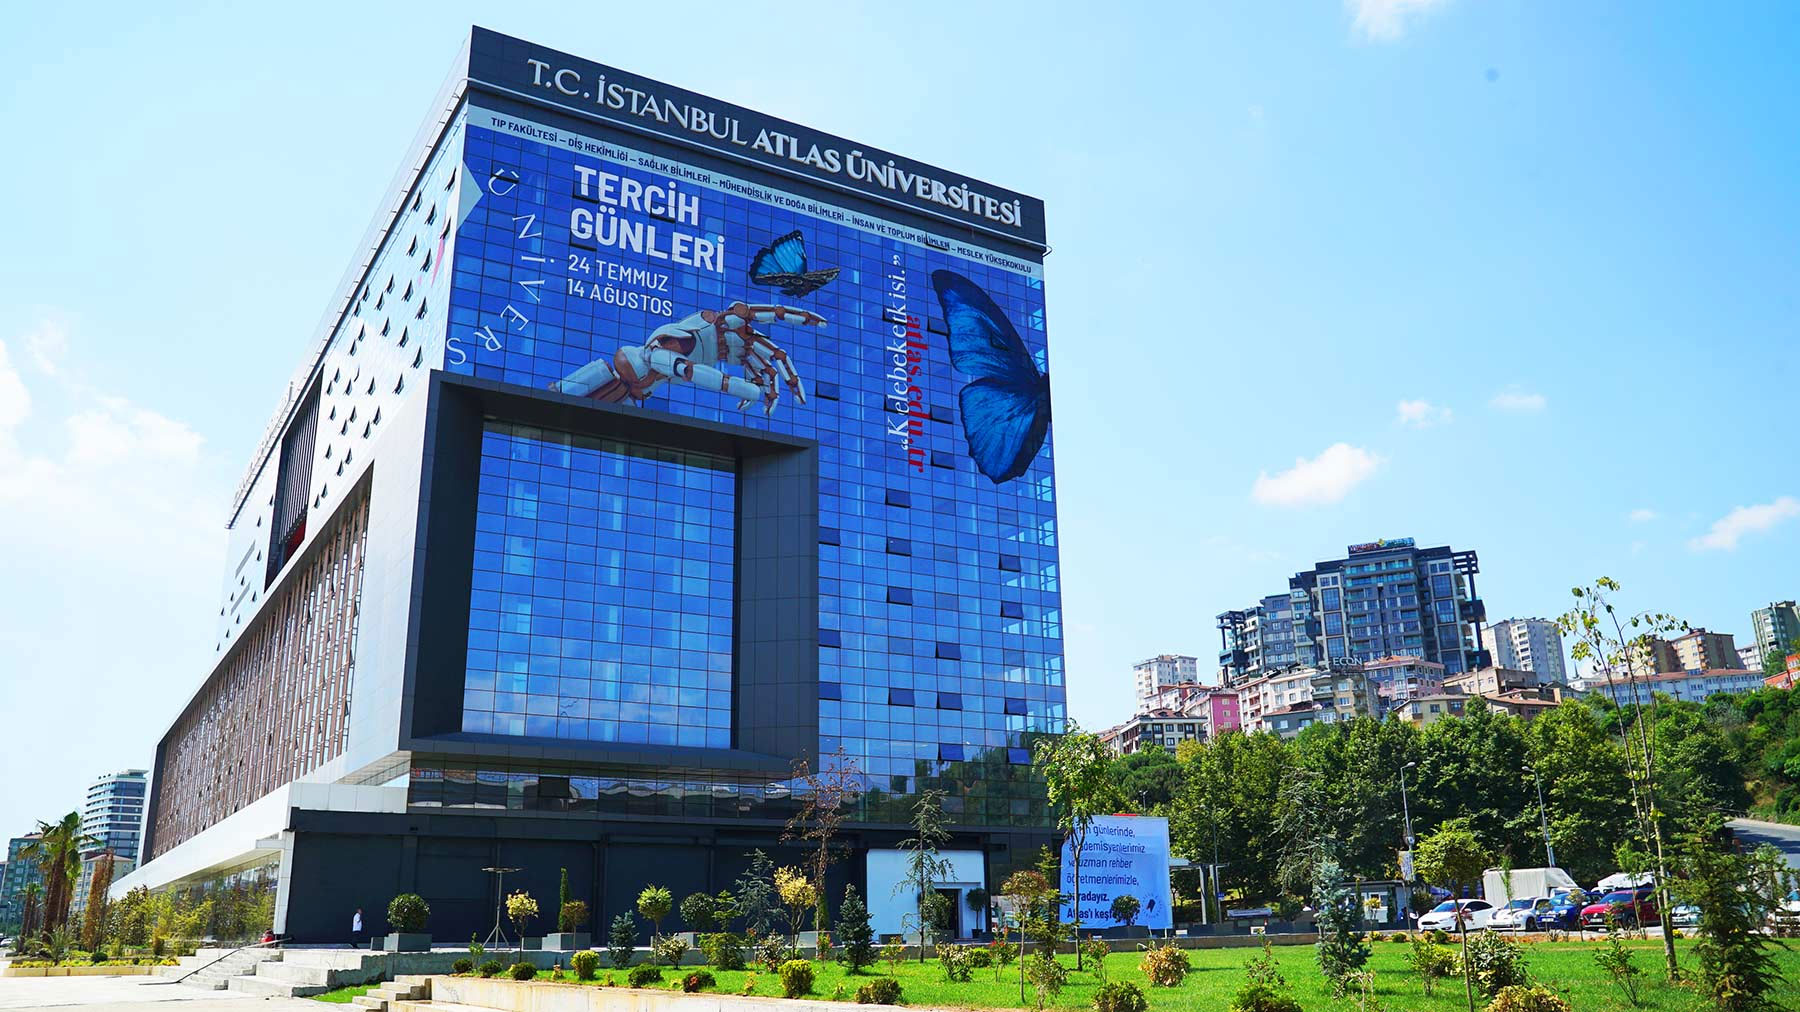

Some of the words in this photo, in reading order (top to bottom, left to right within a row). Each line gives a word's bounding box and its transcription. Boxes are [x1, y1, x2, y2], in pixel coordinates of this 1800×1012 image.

[527, 58, 590, 99] T.C.
[596, 74, 748, 146] İSTANBUL
[751, 128, 842, 174] ATLAS
[846, 150, 1023, 228] ÜNİVERSİTESİ
[491, 117, 507, 127] TIP
[508, 122, 558, 143] FAKÜLTESİ
[568, 137, 583, 150] DİŞ
[584, 143, 629, 162] HEKİMLİĞİ
[638, 157, 669, 172] SAĞLIK
[670, 165, 711, 184] BİLİMLERİ
[719, 179, 773, 201] MÜHENDİSLİK
[774, 194, 785, 205] VE
[785, 197, 807, 211] DOĞA
[808, 203, 845, 222] BİLİMLERİ
[852, 215, 875, 230] İNSAN
[876, 223, 886, 233] VE
[887, 226, 915, 241] TOPLUM
[956, 243, 984, 261] MESLEK
[985, 253, 1032, 274] YÜKSEKOKULU
[574, 165, 699, 226] TERCİH
[571, 205, 725, 273] GÜNLERİ
[567, 278, 585, 297] 14
[590, 283, 673, 317] AĞUSTOS
[568, 254, 590, 274] 24
[596, 259, 669, 292] TEMMUZ
[906, 315, 932, 473] atlas.edu.tr
[1109, 858, 1134, 869] rehber
